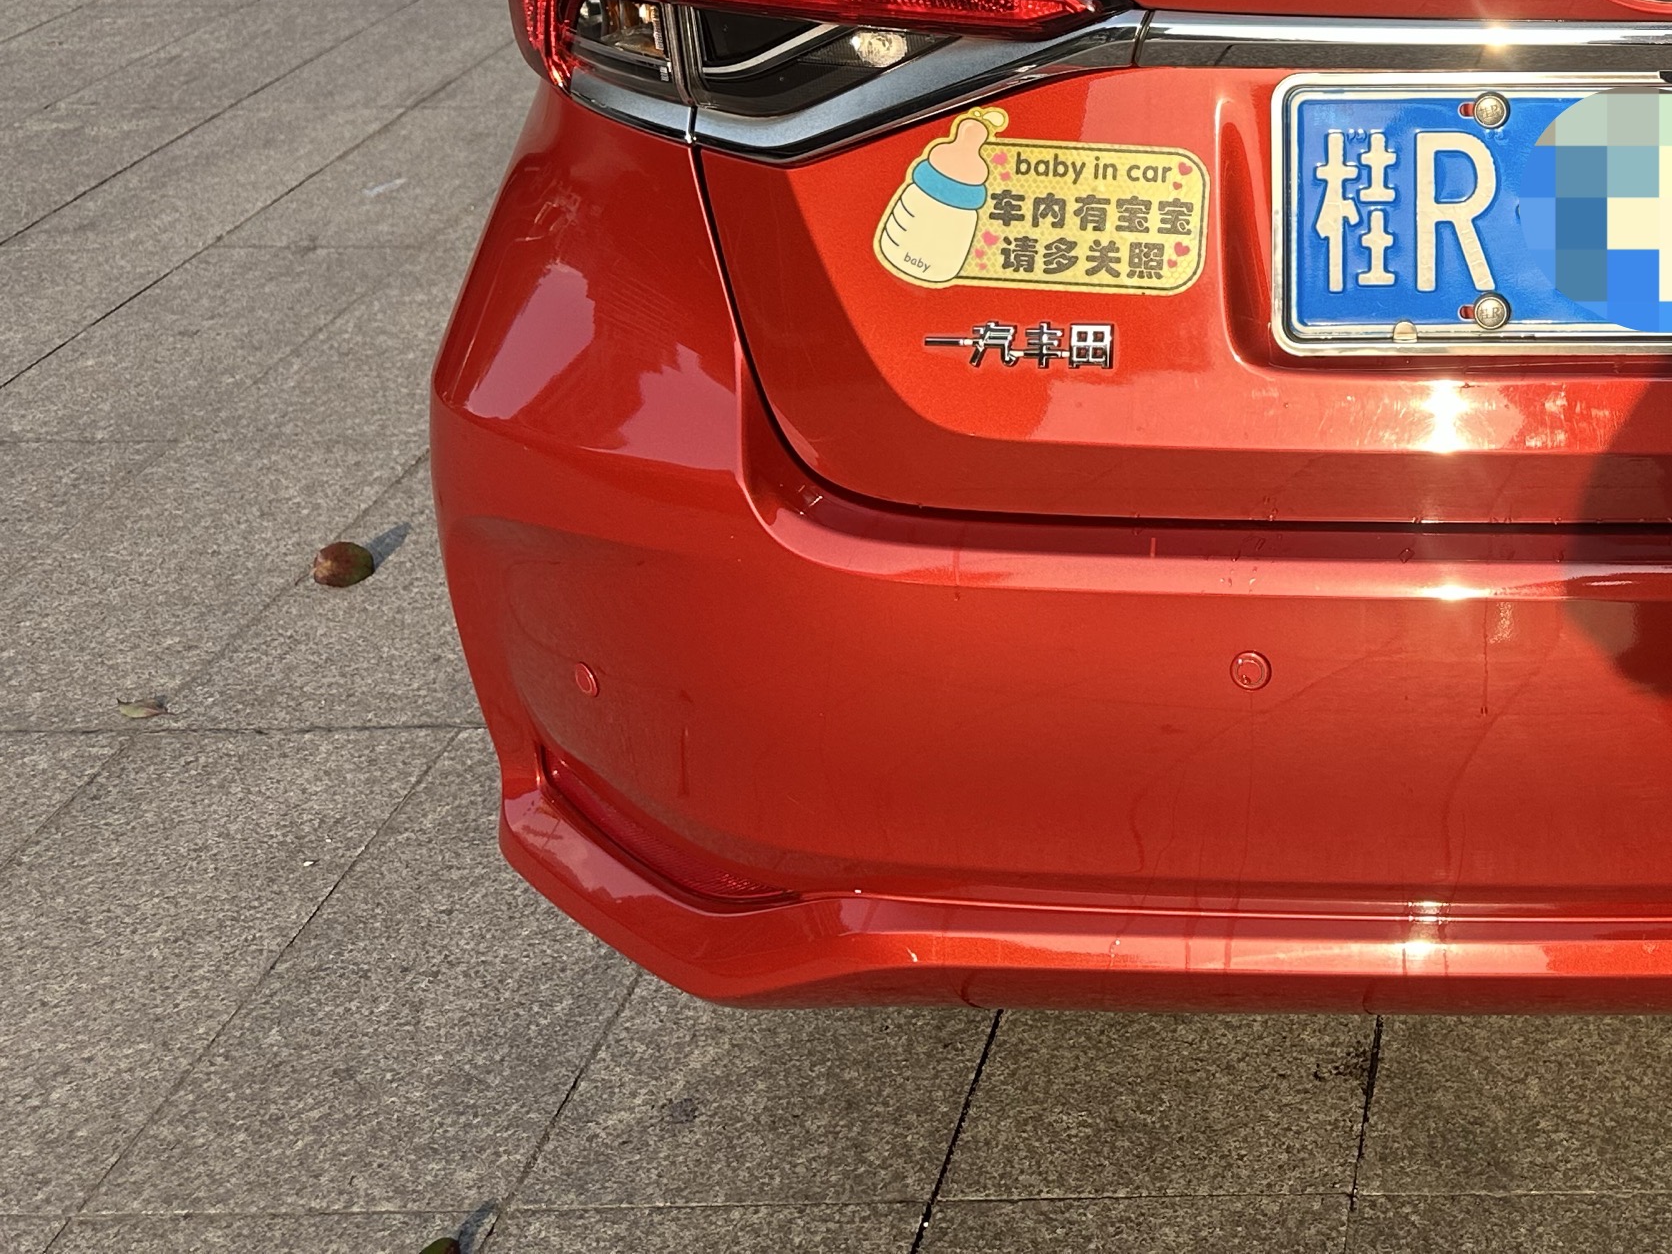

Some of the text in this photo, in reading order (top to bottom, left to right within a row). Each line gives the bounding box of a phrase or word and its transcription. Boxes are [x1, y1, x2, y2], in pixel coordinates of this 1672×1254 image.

[1015, 151, 1173, 184] baby in car
[989, 189, 1194, 236] 车内有宝宝
[903, 253, 932, 272] baby
[1001, 236, 1166, 280] 请多关照
[924, 321, 1115, 370] 一汽丰田
